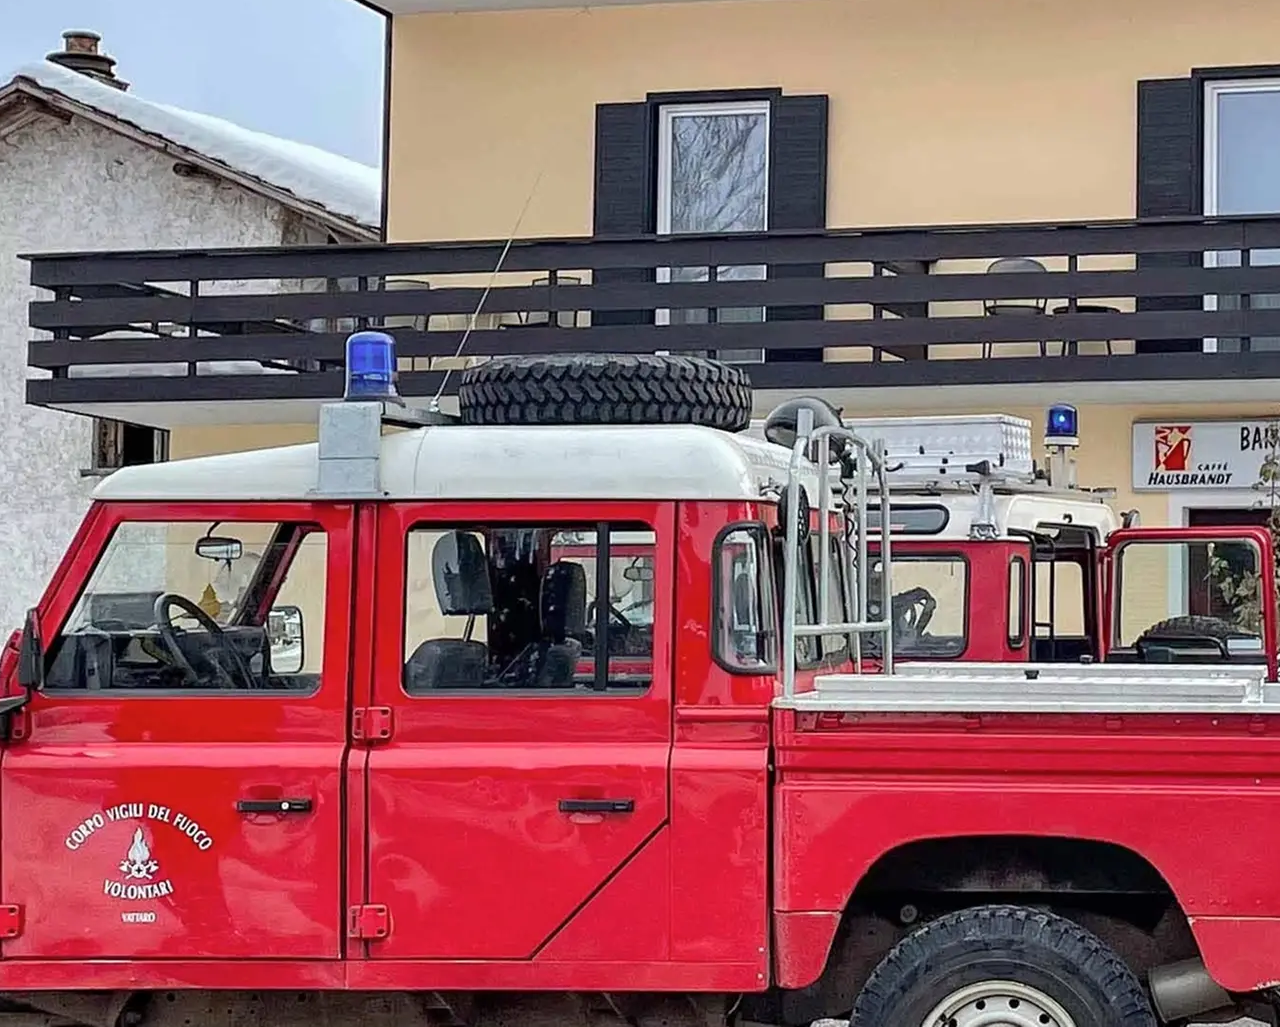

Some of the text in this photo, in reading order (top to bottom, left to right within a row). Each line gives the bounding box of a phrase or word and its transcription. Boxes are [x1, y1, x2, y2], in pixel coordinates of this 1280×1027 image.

[1147, 472, 1233, 485] HAUSBRANDT
[64, 803, 213, 851] CORPO VIGILI DEL FUOCO
[104, 879, 174, 900] VOLONTARI
